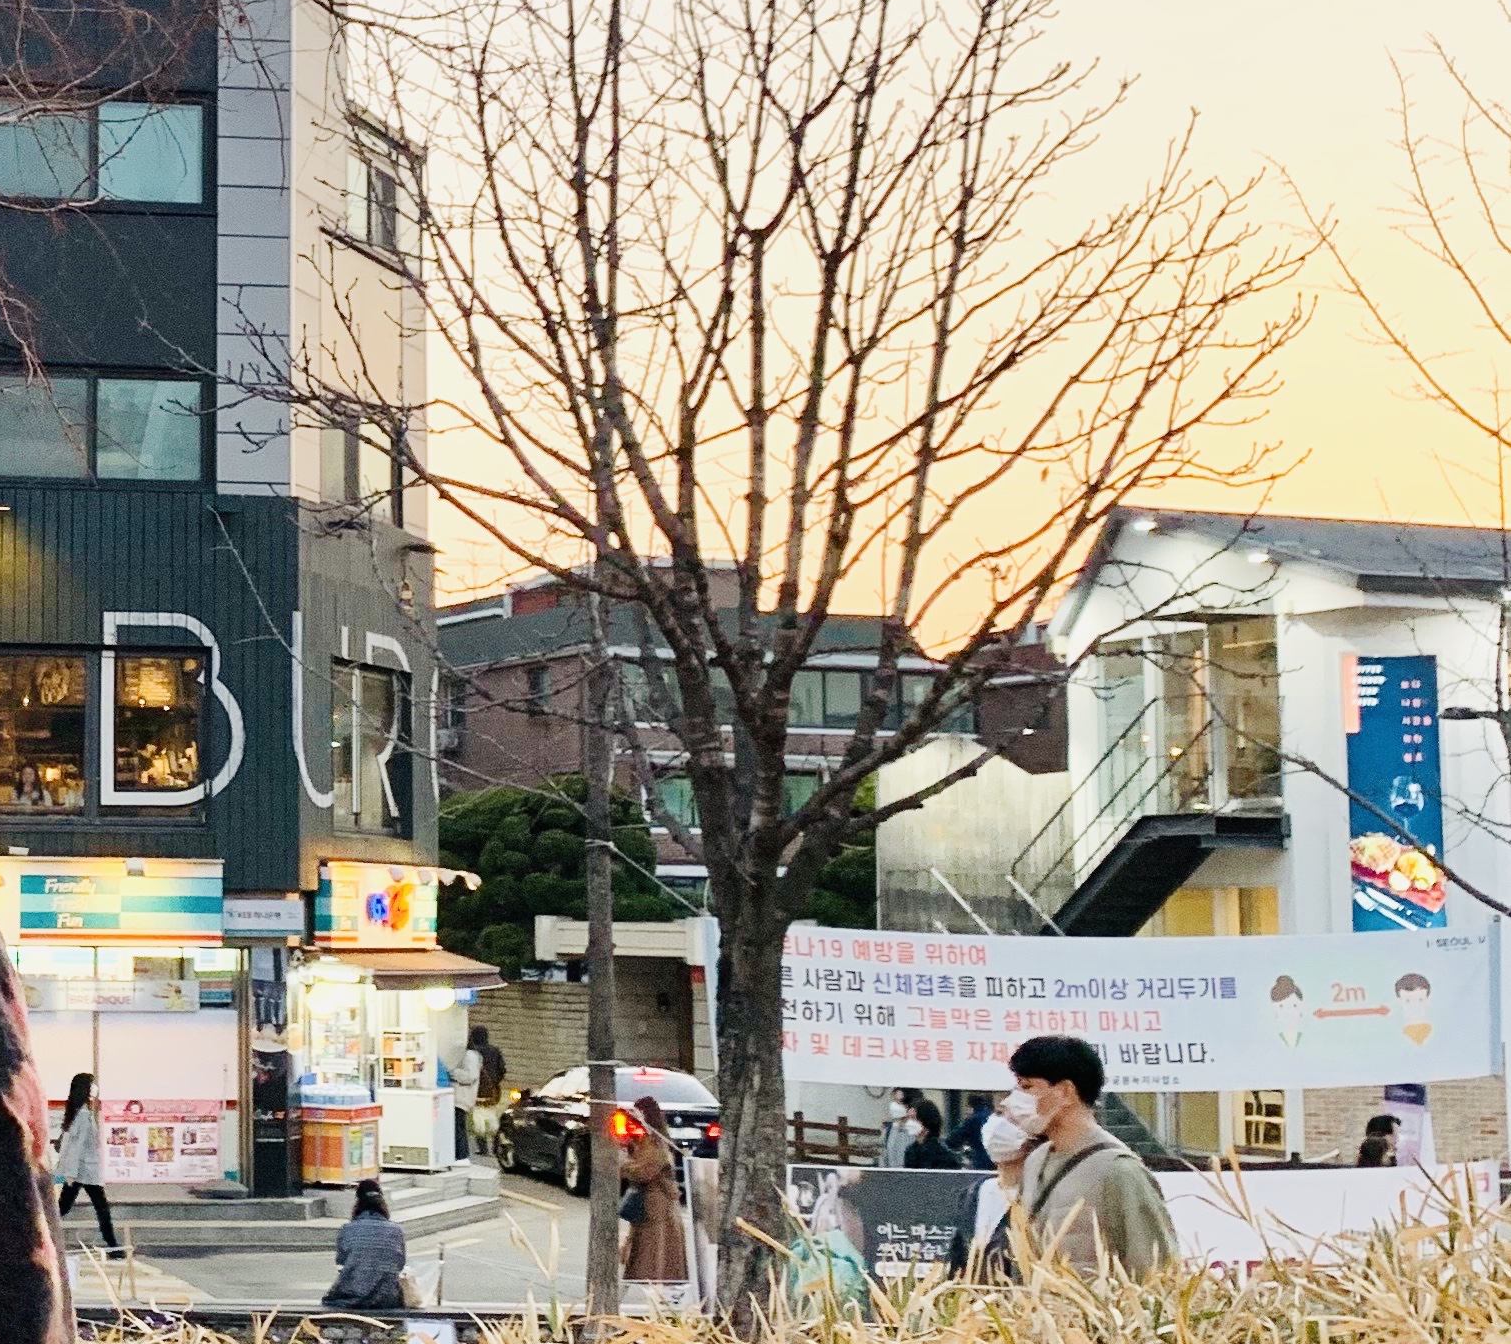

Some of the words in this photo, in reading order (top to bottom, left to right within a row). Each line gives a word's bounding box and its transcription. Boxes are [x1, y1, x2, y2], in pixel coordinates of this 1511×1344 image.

[44, 878, 97, 895] Friendly
[56, 913, 84, 928] Fun
[853, 939, 915, 964] 예방을
[925, 942, 988, 966] 위하여
[803, 967, 865, 992] 사람과
[873, 971, 977, 999] 신체접촉을
[986, 976, 1046, 999] 피하고
[1054, 977, 1129, 1001] 2m이상
[1136, 976, 1237, 1000] 거리두기를
[1331, 983, 1366, 1002] 2m
[68, 994, 132, 1005] BREADIQUE
[854, 1003, 896, 1027] 위해
[907, 1006, 992, 1031] 그늘막은
[1003, 1009, 1089, 1033] 설치하지
[1098, 1010, 1163, 1032] 마시고
[810, 1032, 829, 1055] 및
[842, 1035, 955, 1062] 데크사용을
[966, 1040, 1018, 1065] 자제
[1119, 1042, 1215, 1065] 바랍니다.
[876, 1222, 908, 1241] 어느
